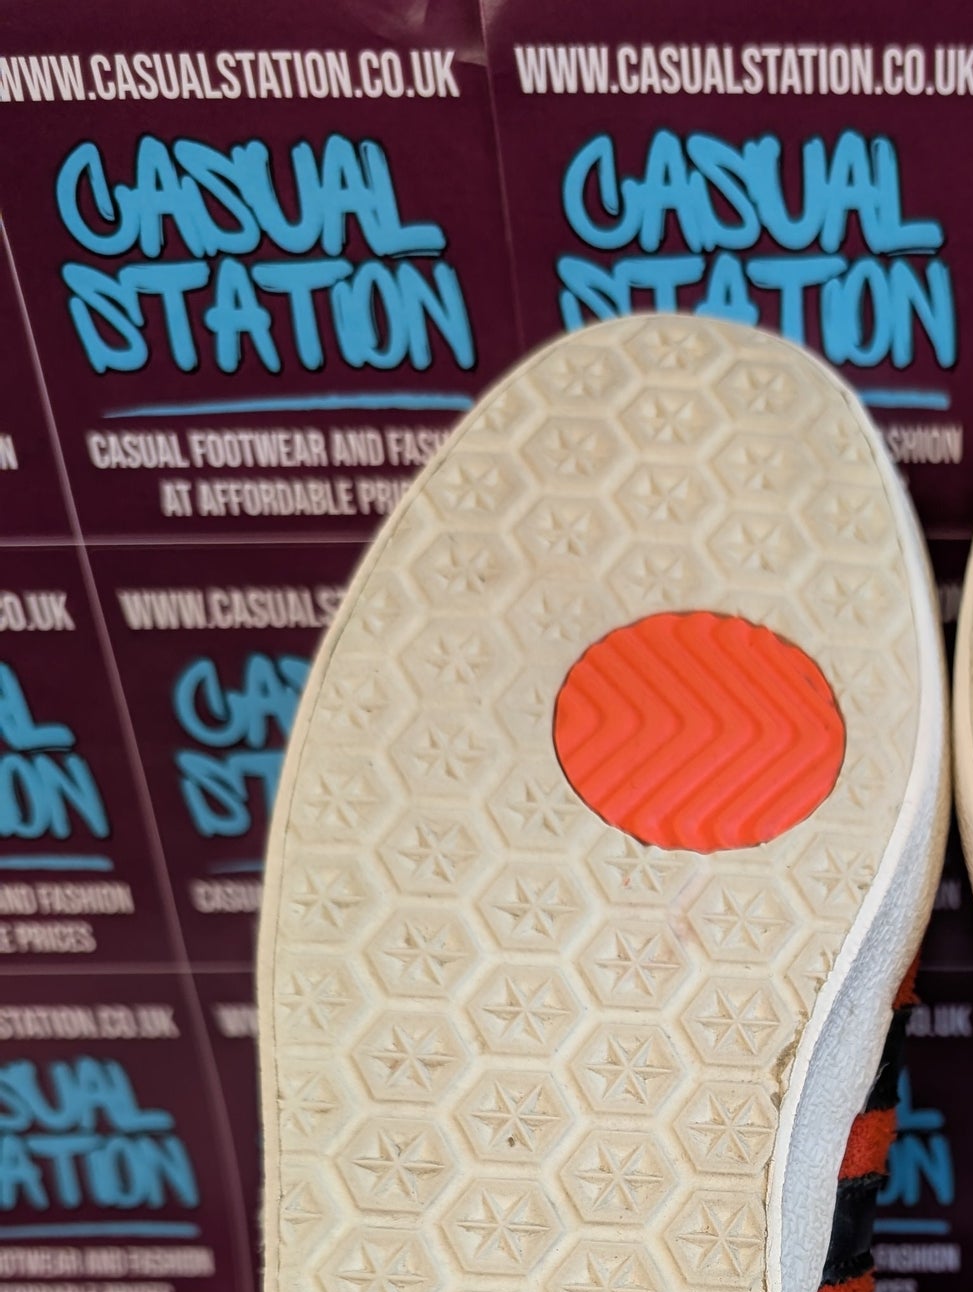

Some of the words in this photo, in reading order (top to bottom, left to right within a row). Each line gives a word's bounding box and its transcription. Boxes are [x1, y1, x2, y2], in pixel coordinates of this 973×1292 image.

[56, 134, 447, 258] CASUAL
[562, 130, 945, 257] CASUAL
[61, 257, 477, 374] STATION
[87, 428, 189, 469] CASUAL
[194, 427, 329, 468] FOOTWEAR
[330, 427, 386, 467] AND
[160, 479, 194, 518] AT
[200, 476, 358, 517] AFFORDABLE
